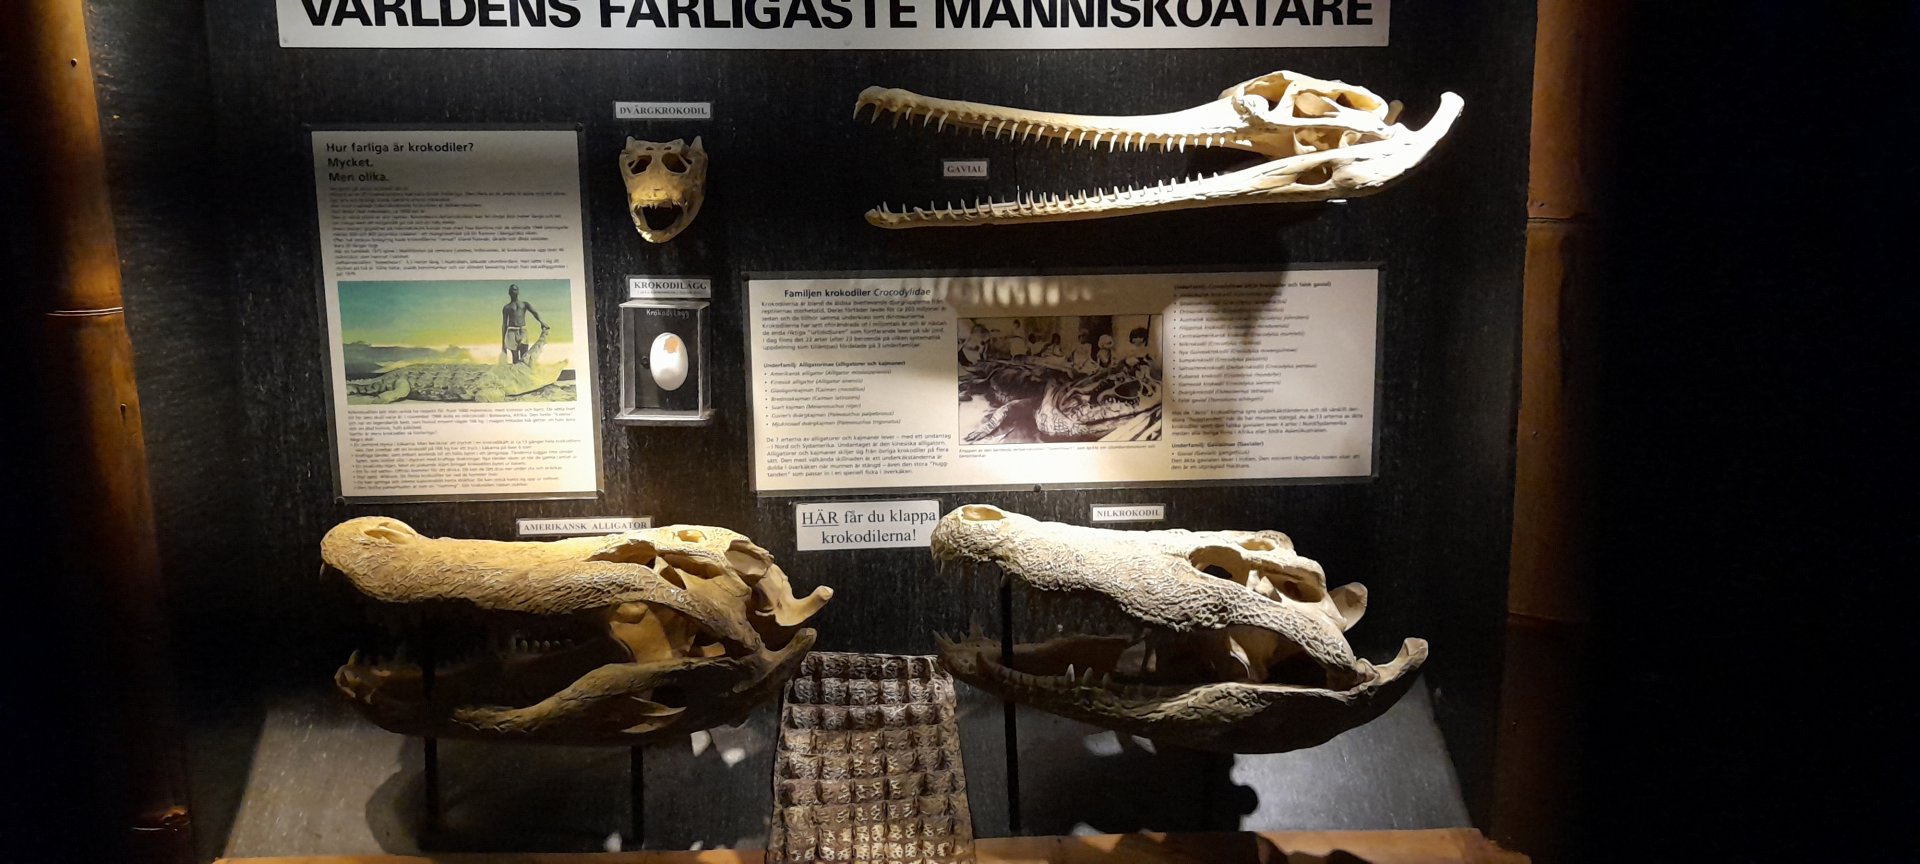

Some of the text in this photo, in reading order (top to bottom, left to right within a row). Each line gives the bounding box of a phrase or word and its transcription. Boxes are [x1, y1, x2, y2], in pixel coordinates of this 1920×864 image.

[326, 142, 473, 154] Hur farliga är krokodiler?
[327, 157, 373, 169] Mycket.
[947, 165, 984, 173] GAVIAL
[328, 172, 390, 182] Men olika.
[784, 287, 932, 299] Familjen krokodiler Crocodylidae
[802, 508, 936, 527] HÄR får du klappa
[1096, 509, 1160, 518] NILKROKODIL
[523, 522, 647, 532] AMERIKANSK ALLIGATOR
[822, 529, 917, 544] krokodilerna!
